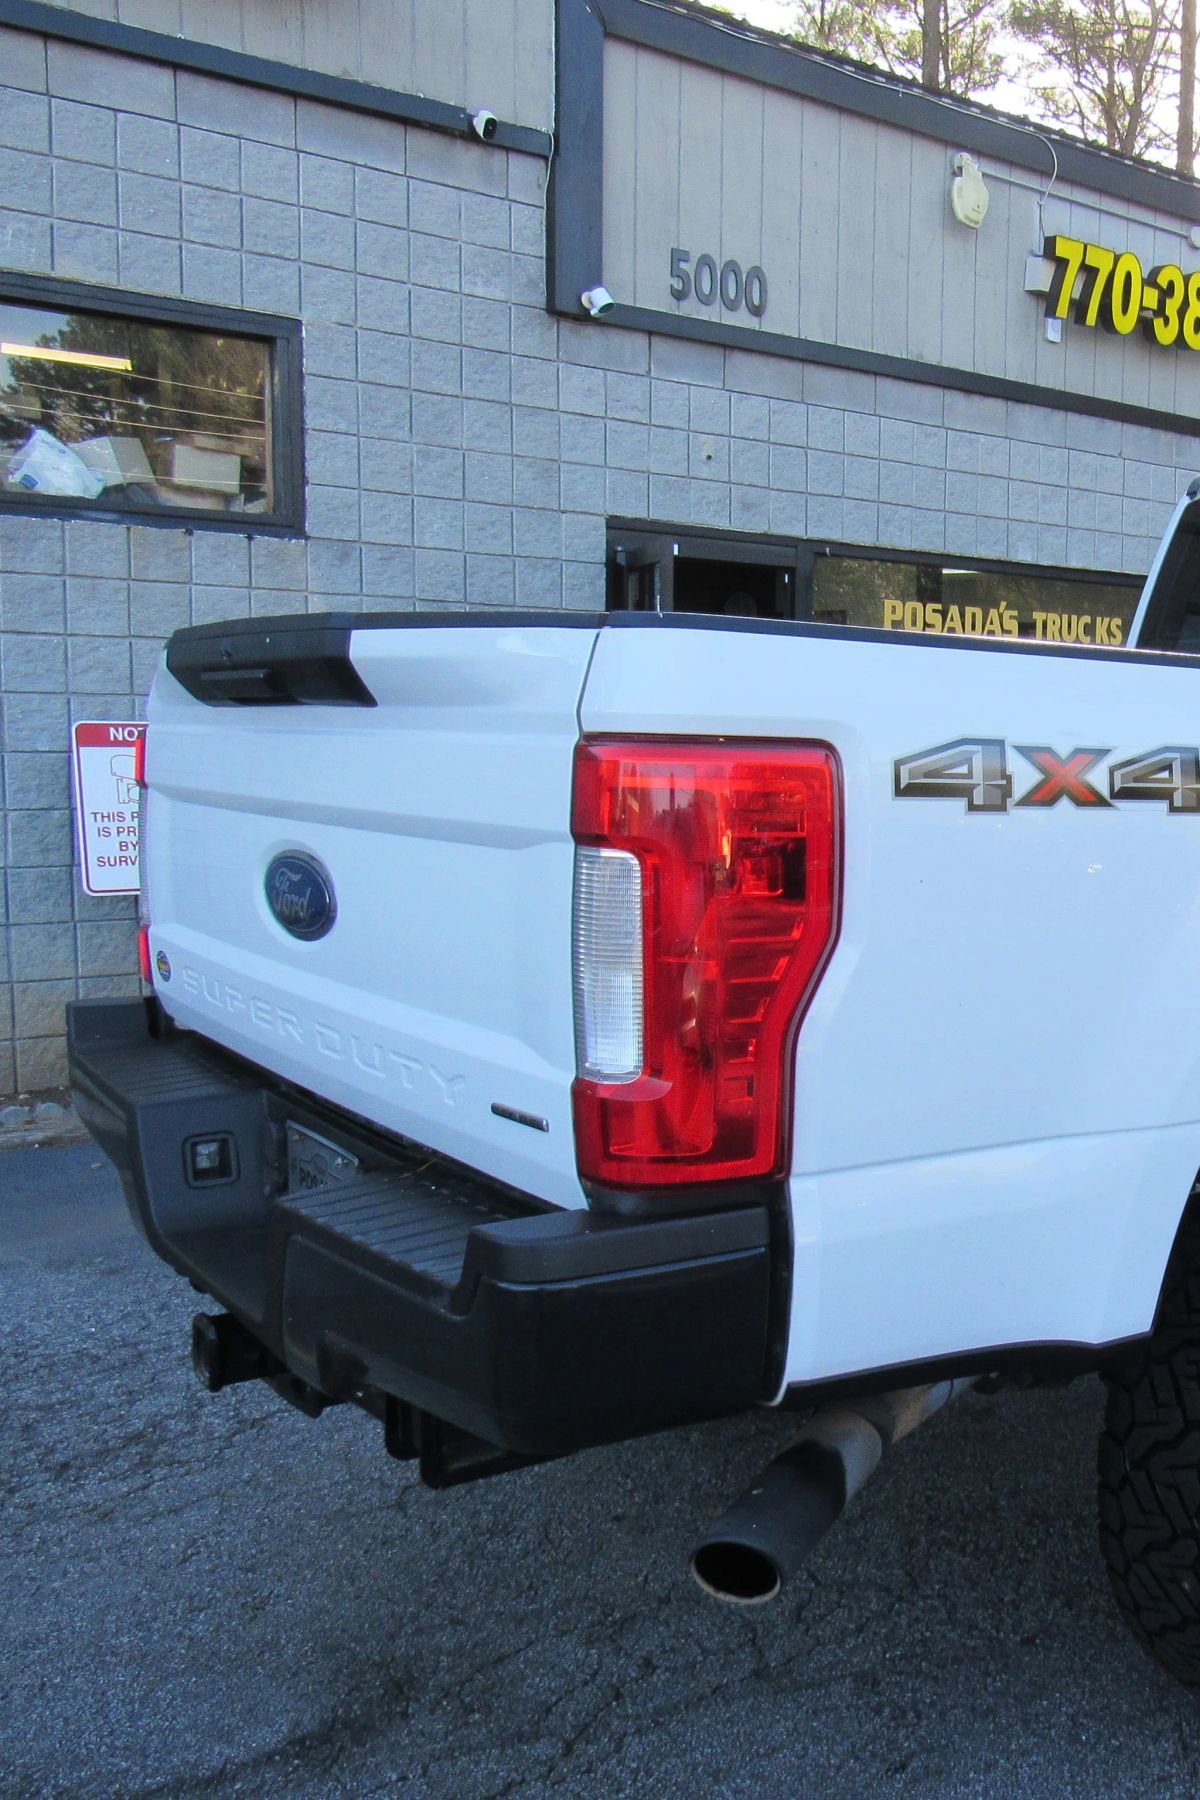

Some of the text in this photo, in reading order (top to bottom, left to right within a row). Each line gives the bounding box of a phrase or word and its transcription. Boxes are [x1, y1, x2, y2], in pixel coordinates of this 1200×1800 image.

[669, 247, 768, 317] 5000
[883, 599, 1123, 646] POSADA'S TRUCKS
[109, 726, 145, 741] NO
[90, 811, 126, 823] THIS
[97, 826, 112, 838] IS
[119, 840, 139, 852] BY
[272, 867, 315, 925] Ford
[183, 967, 467, 1104] SUPER DUTY
